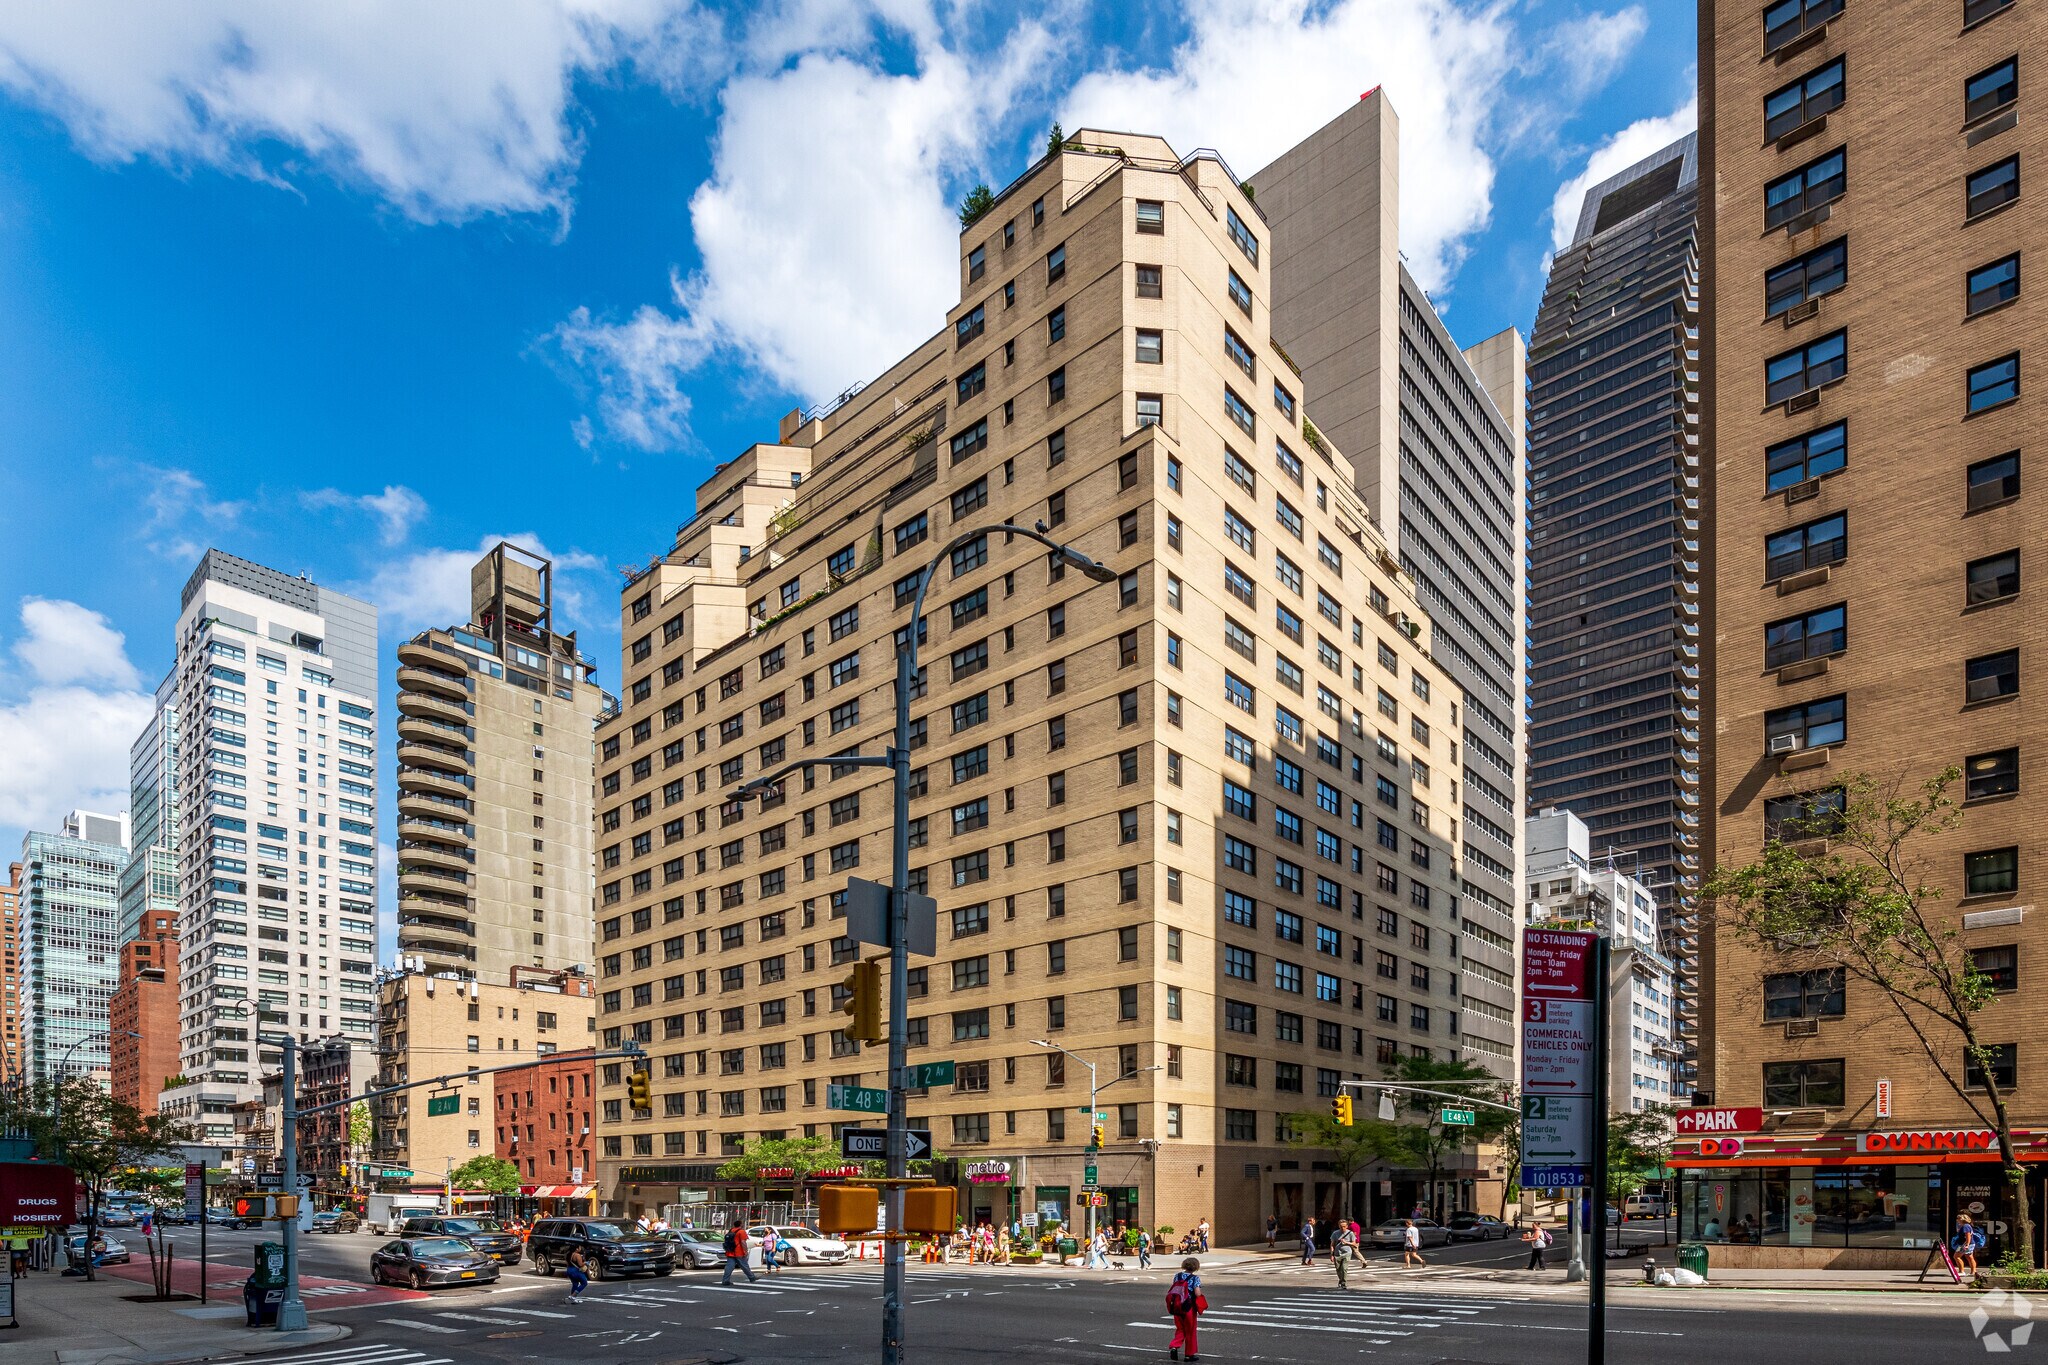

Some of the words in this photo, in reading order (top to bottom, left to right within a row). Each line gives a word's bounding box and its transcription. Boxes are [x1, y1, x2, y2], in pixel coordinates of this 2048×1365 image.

[1527, 933, 1540, 942] NO
[1543, 934, 1587, 946] STANDING
[1527, 948, 1553, 959] Monday
[1560, 950, 1581, 960] Friday
[1527, 958, 1542, 966] 7am
[1548, 959, 1566, 967] 10am
[1527, 967, 1542, 976] 2pm
[1548, 968, 1563, 977] 7pm
[1530, 1000, 1541, 1020] 3
[1548, 1017, 1570, 1025] parking
[1526, 1028, 1583, 1039] COMMERCIAL
[1526, 1040, 1568, 1050] VEHICLES
[1571, 1041, 1593, 1051] ONLY
[1526, 1055, 1552, 1064] Monday
[1559, 1056, 1580, 1065] Friday
[1526, 1064, 1544, 1072] 10am
[1550, 1065, 1565, 1074] 2pm
[925, 1067, 931, 1084] 2
[936, 1066, 944, 1077] Av
[844, 1090, 850, 1107] E
[856, 1091, 871, 1109] 48
[876, 1093, 884, 1104] St
[1879, 1083, 1887, 1114] DUNKIN'
[1529, 1097, 1541, 1118] 2
[1448, 1112, 1452, 1121] E
[1453, 1113, 1461, 1121] 48
[1548, 1113, 1569, 1121] parking
[1696, 1111, 1737, 1130] PARK
[1526, 1125, 1557, 1134] Saturday
[856, 1138, 881, 1150] ONE
[906, 1139, 919, 1151] AY
[1547, 1135, 1562, 1143] 7pm
[967, 1160, 1006, 1174] metro
[1533, 1172, 1575, 1185] 101853
